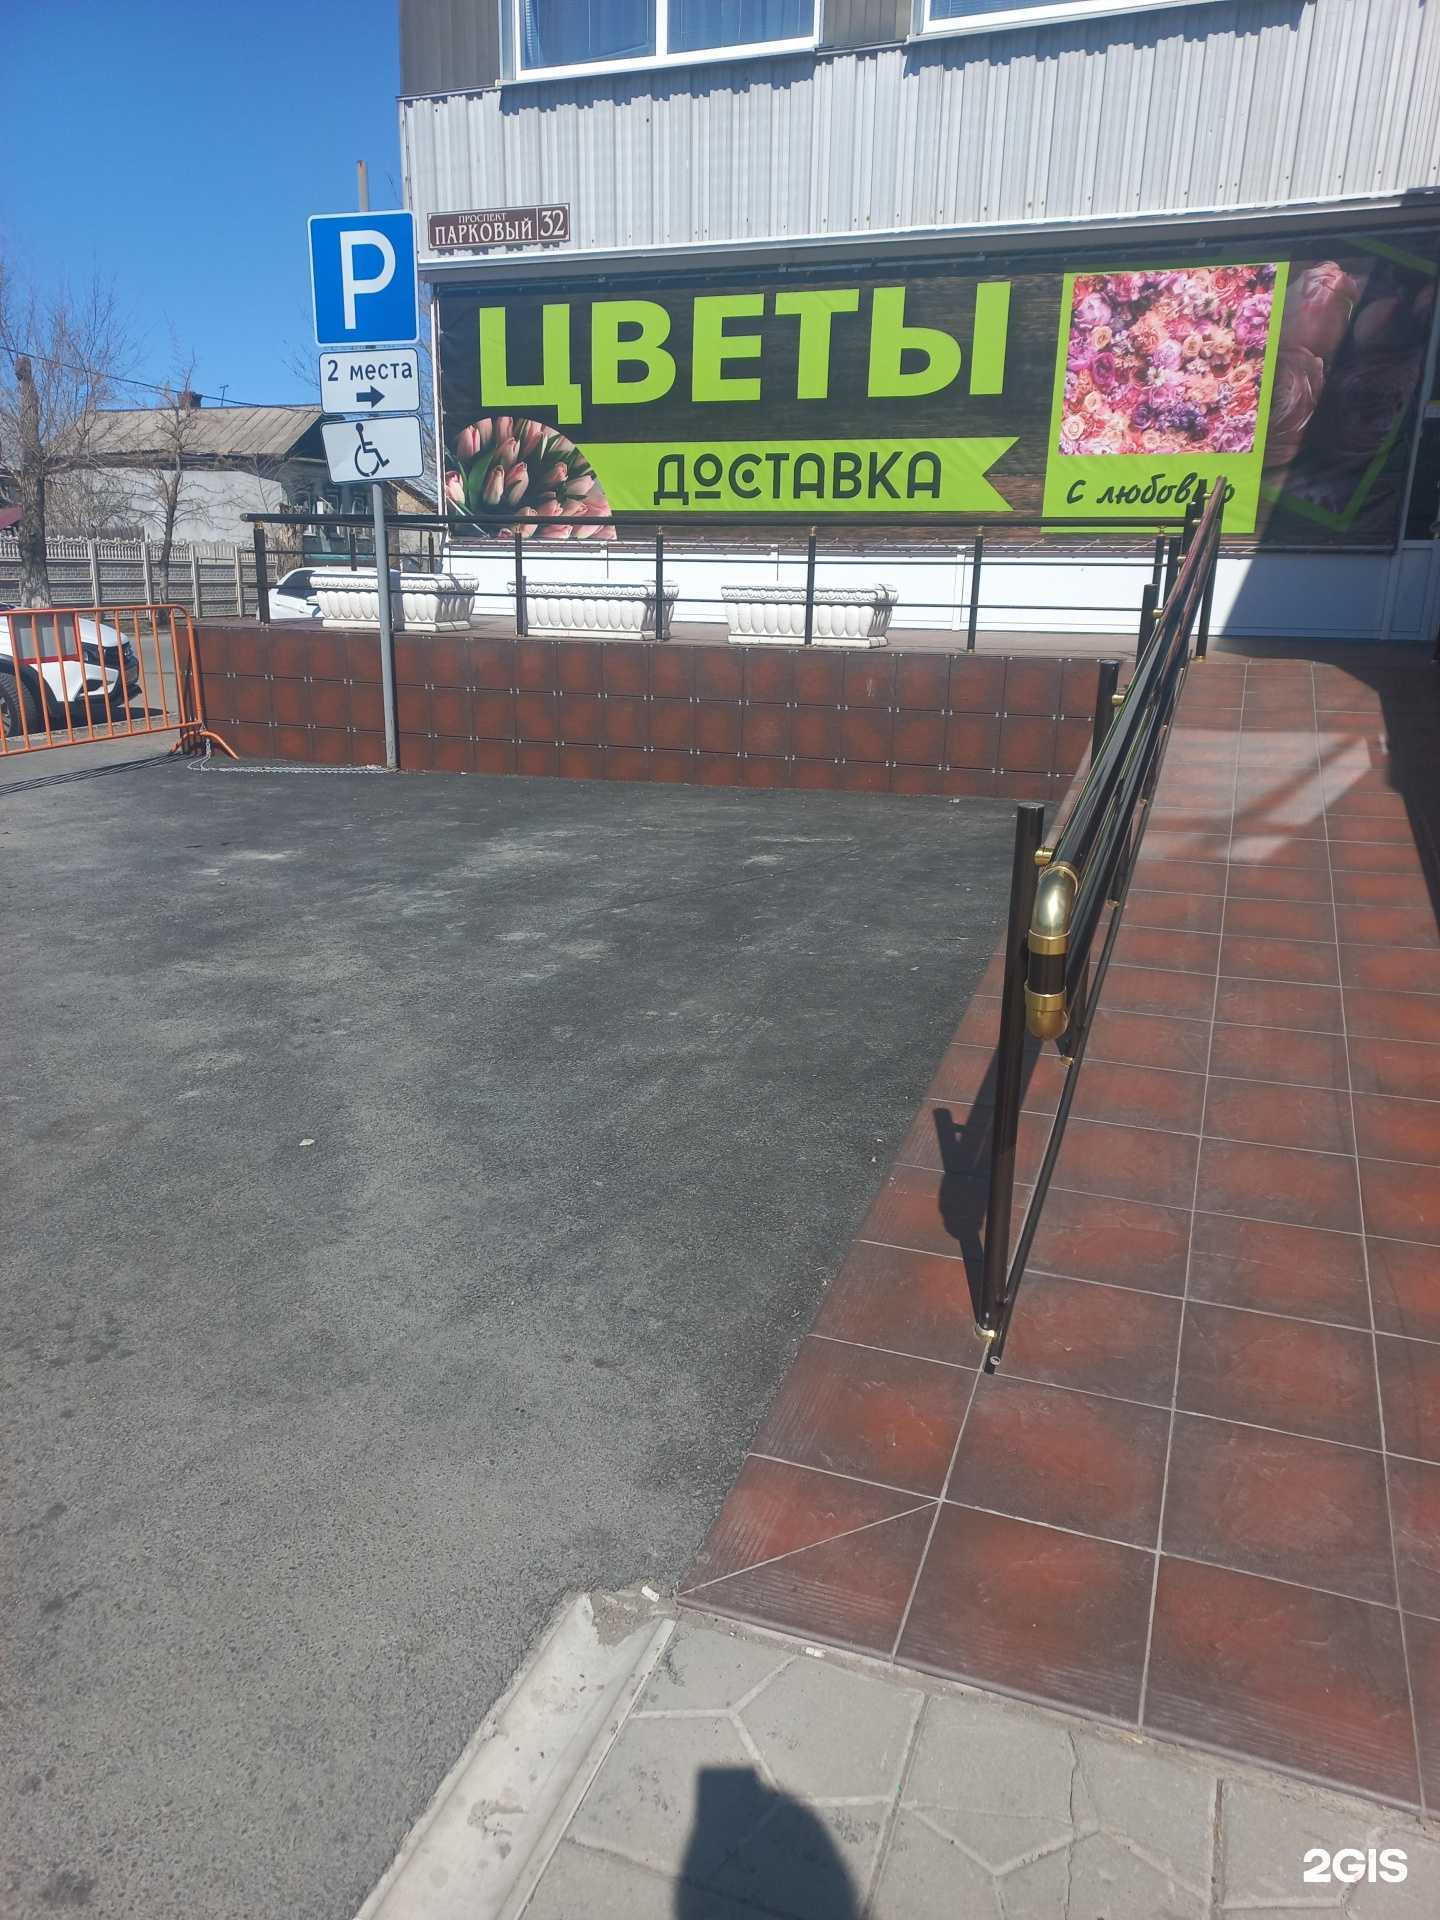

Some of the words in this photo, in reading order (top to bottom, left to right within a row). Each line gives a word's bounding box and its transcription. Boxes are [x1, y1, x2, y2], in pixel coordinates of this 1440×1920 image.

[434, 217, 533, 245] ПАРКОВЫЙ
[540, 209, 565, 237] 32
[458, 212, 507, 224] ПРОСПЕКТ
[339, 229, 397, 331] P
[327, 359, 339, 382] 2
[350, 362, 413, 381] места
[478, 280, 1012, 425] ЦВЕТЫ
[653, 450, 942, 506] ДОСТАВКА
[1096, 472, 1236, 505] любов
